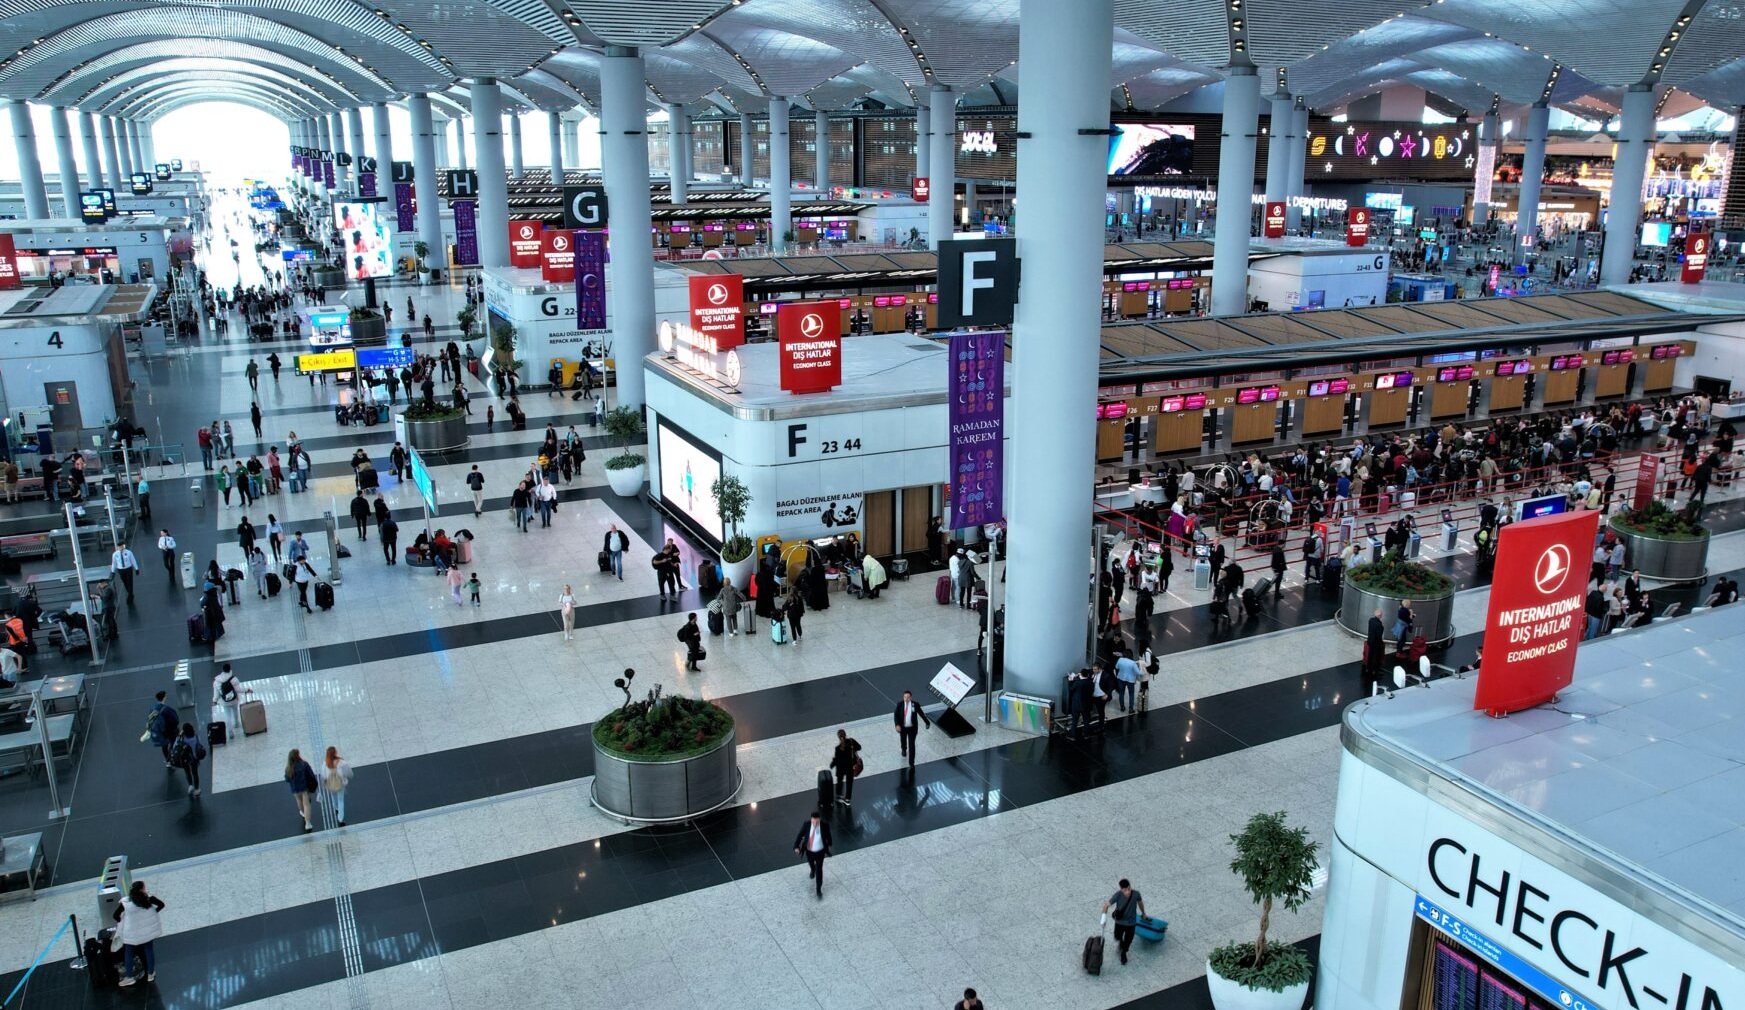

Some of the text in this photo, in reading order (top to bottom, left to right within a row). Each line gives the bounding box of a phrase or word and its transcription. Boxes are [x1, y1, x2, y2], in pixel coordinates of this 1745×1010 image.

[311, 150, 318, 158] N
[321, 151, 333, 161] M
[340, 154, 347, 165] L
[361, 158, 371, 171] K
[399, 163, 406, 180] J
[452, 173, 471, 194] H
[1146, 187, 1170, 198] HATLAR
[1171, 187, 1192, 200] GİDEN
[1193, 190, 1216, 201] YOLCU
[572, 191, 600, 224] G
[1293, 195, 1347, 211] DEPARTURES
[140, 232, 147, 242] 5
[1373, 255, 1383, 270] G
[961, 251, 996, 317] F
[541, 297, 558, 316] G
[695, 306, 741, 316] INTERNATIONAL
[701, 314, 735, 324] DIŞ HATLAR
[47, 331, 63, 349] 4
[566, 329, 597, 337] DÜZENLEME
[785, 340, 837, 351] INTERNATIONAL
[333, 356, 348, 364] Exit
[793, 349, 831, 360] DIŞ HATLAR
[793, 360, 831, 369] ECONOMY CLASS
[953, 419, 1000, 434] RAMADAN
[788, 423, 862, 458] F 23 44
[957, 431, 996, 445] KAREEM
[776, 491, 863, 508] BAGAJ DÜZENLEME ALANI
[776, 506, 822, 517] REPACK AREA
[1499, 594, 1581, 626] INTERNATIONAL
[1510, 614, 1572, 644] DIŞ HATLAR
[1507, 638, 1568, 663] ECONOMY CLASS
[1441, 913, 1461, 935] F-S
[1462, 927, 1483, 943] Check-in
[1461, 934, 1482, 950] Check-in
